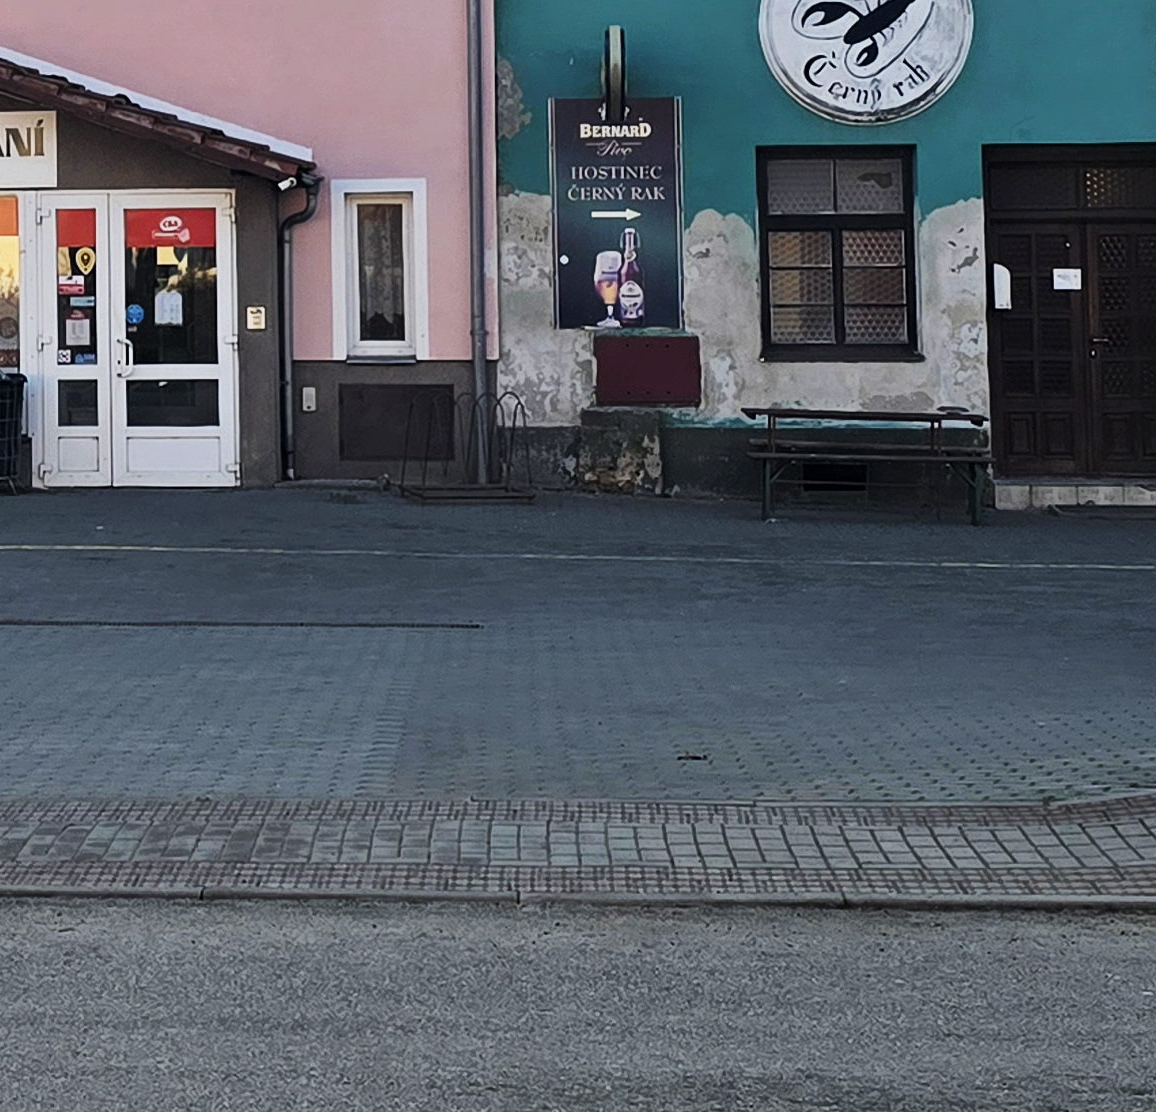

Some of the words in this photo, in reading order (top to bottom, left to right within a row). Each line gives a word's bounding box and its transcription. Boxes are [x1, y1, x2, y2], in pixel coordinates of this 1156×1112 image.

[571, 165, 662, 180] HOSTINEC
[567, 183, 626, 201] ČERNÝ
[631, 187, 665, 200] RAK
